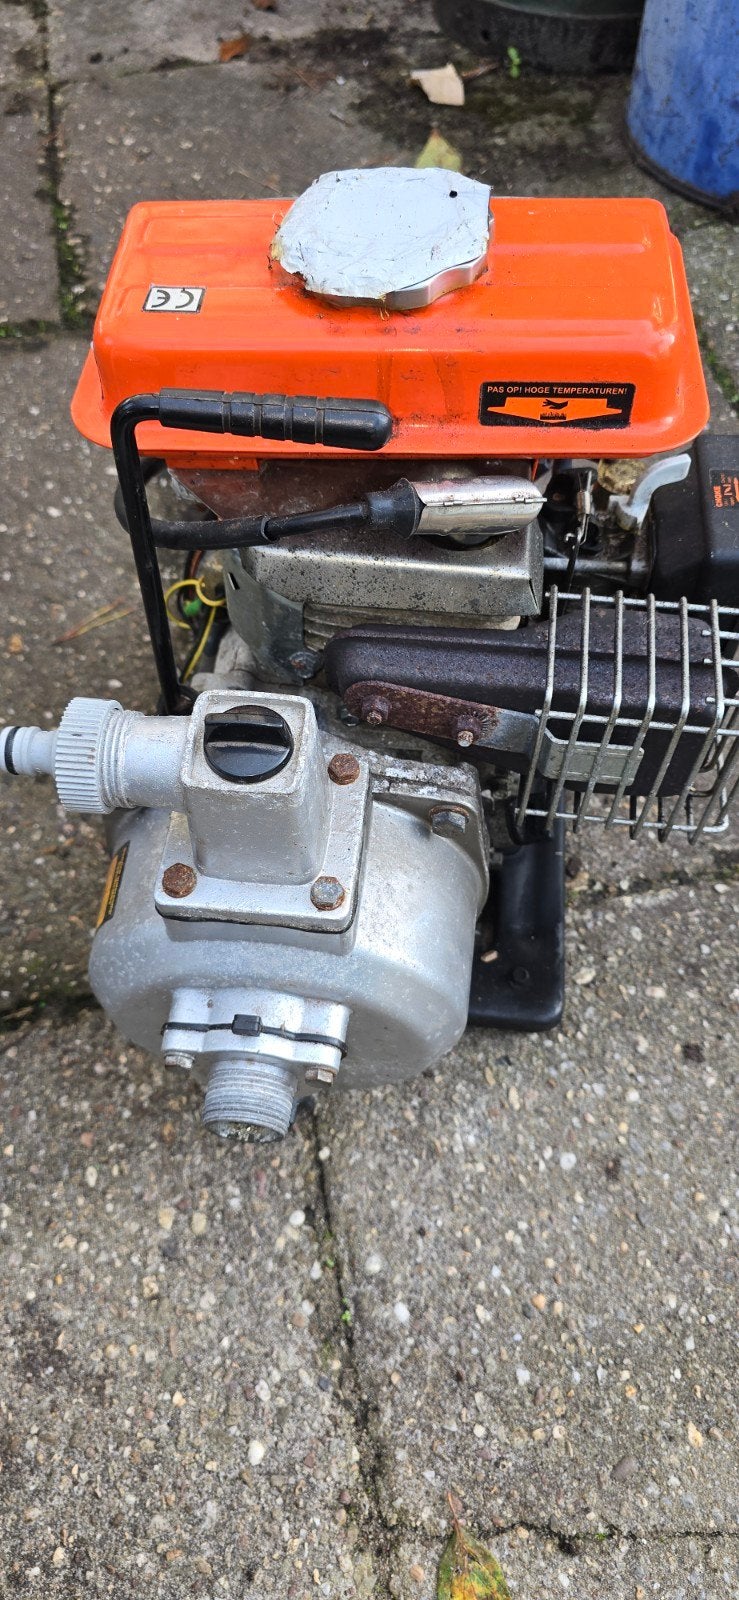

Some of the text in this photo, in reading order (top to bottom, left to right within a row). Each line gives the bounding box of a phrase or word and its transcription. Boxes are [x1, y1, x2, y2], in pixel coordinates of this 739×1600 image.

[487, 386, 628, 395] PAS OP! HOGE TEMPERATUREN!
